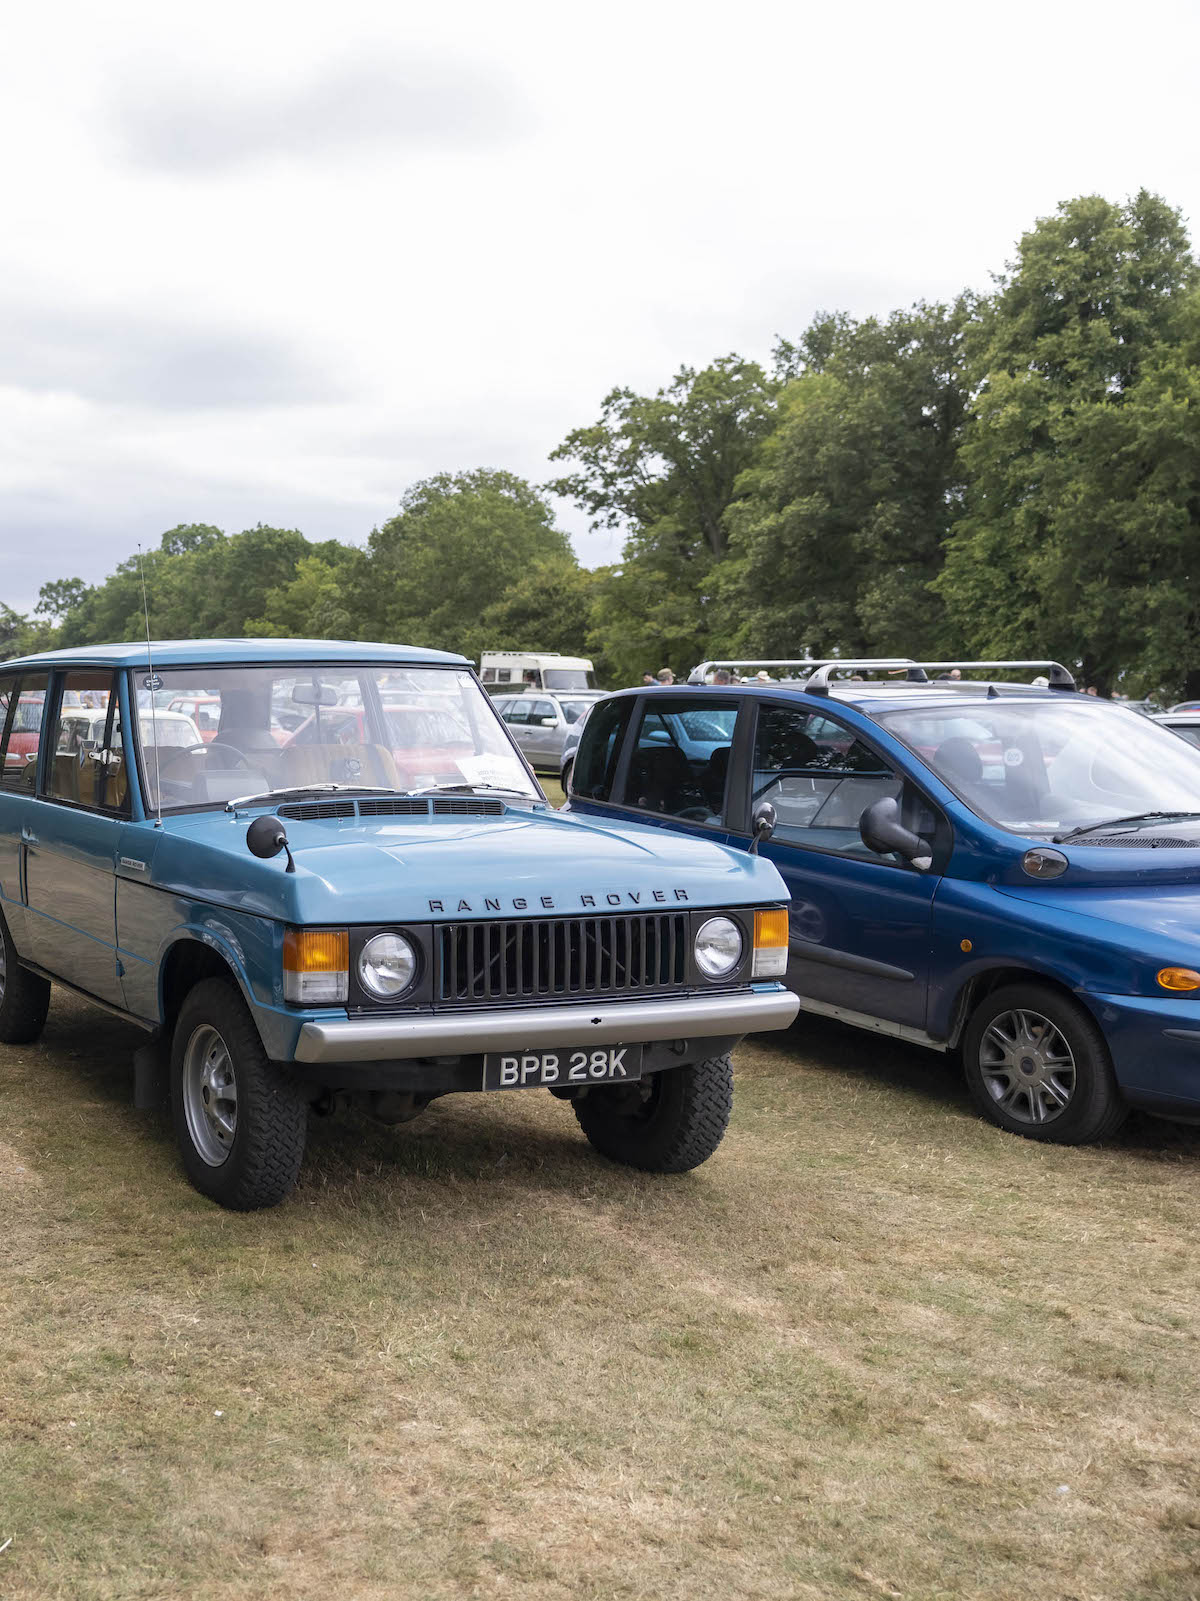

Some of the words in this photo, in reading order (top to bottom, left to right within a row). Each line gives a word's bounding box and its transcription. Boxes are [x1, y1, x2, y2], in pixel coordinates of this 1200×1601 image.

[429, 894, 556, 913] RANGE
[580, 888, 691, 908] ROVER
[499, 1053, 560, 1087] BPB
[568, 1047, 628, 1081] 28K
